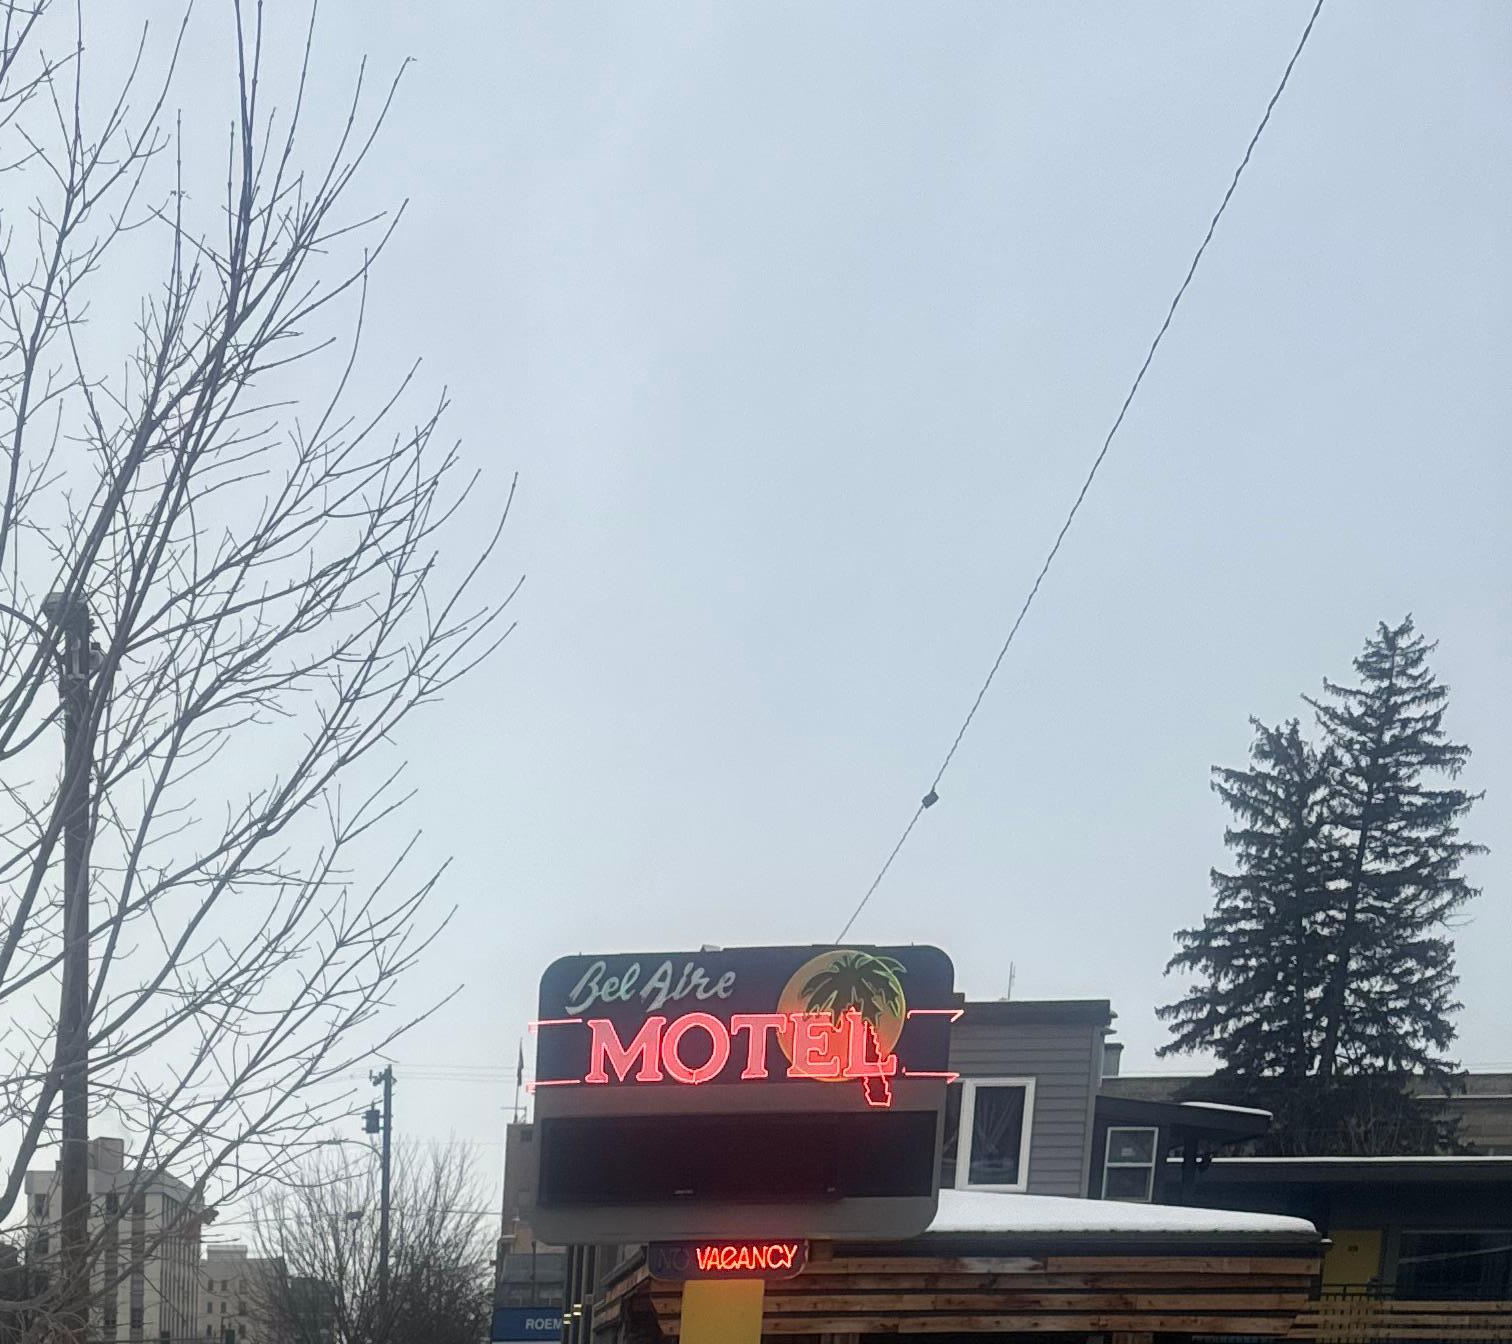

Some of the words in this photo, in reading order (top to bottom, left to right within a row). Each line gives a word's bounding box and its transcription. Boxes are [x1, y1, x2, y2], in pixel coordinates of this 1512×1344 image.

[565, 960, 640, 1015] Bel
[640, 960, 736, 1013] Aire
[585, 1012, 897, 1085] MOTEL
[696, 1244, 798, 1270] VACANCY
